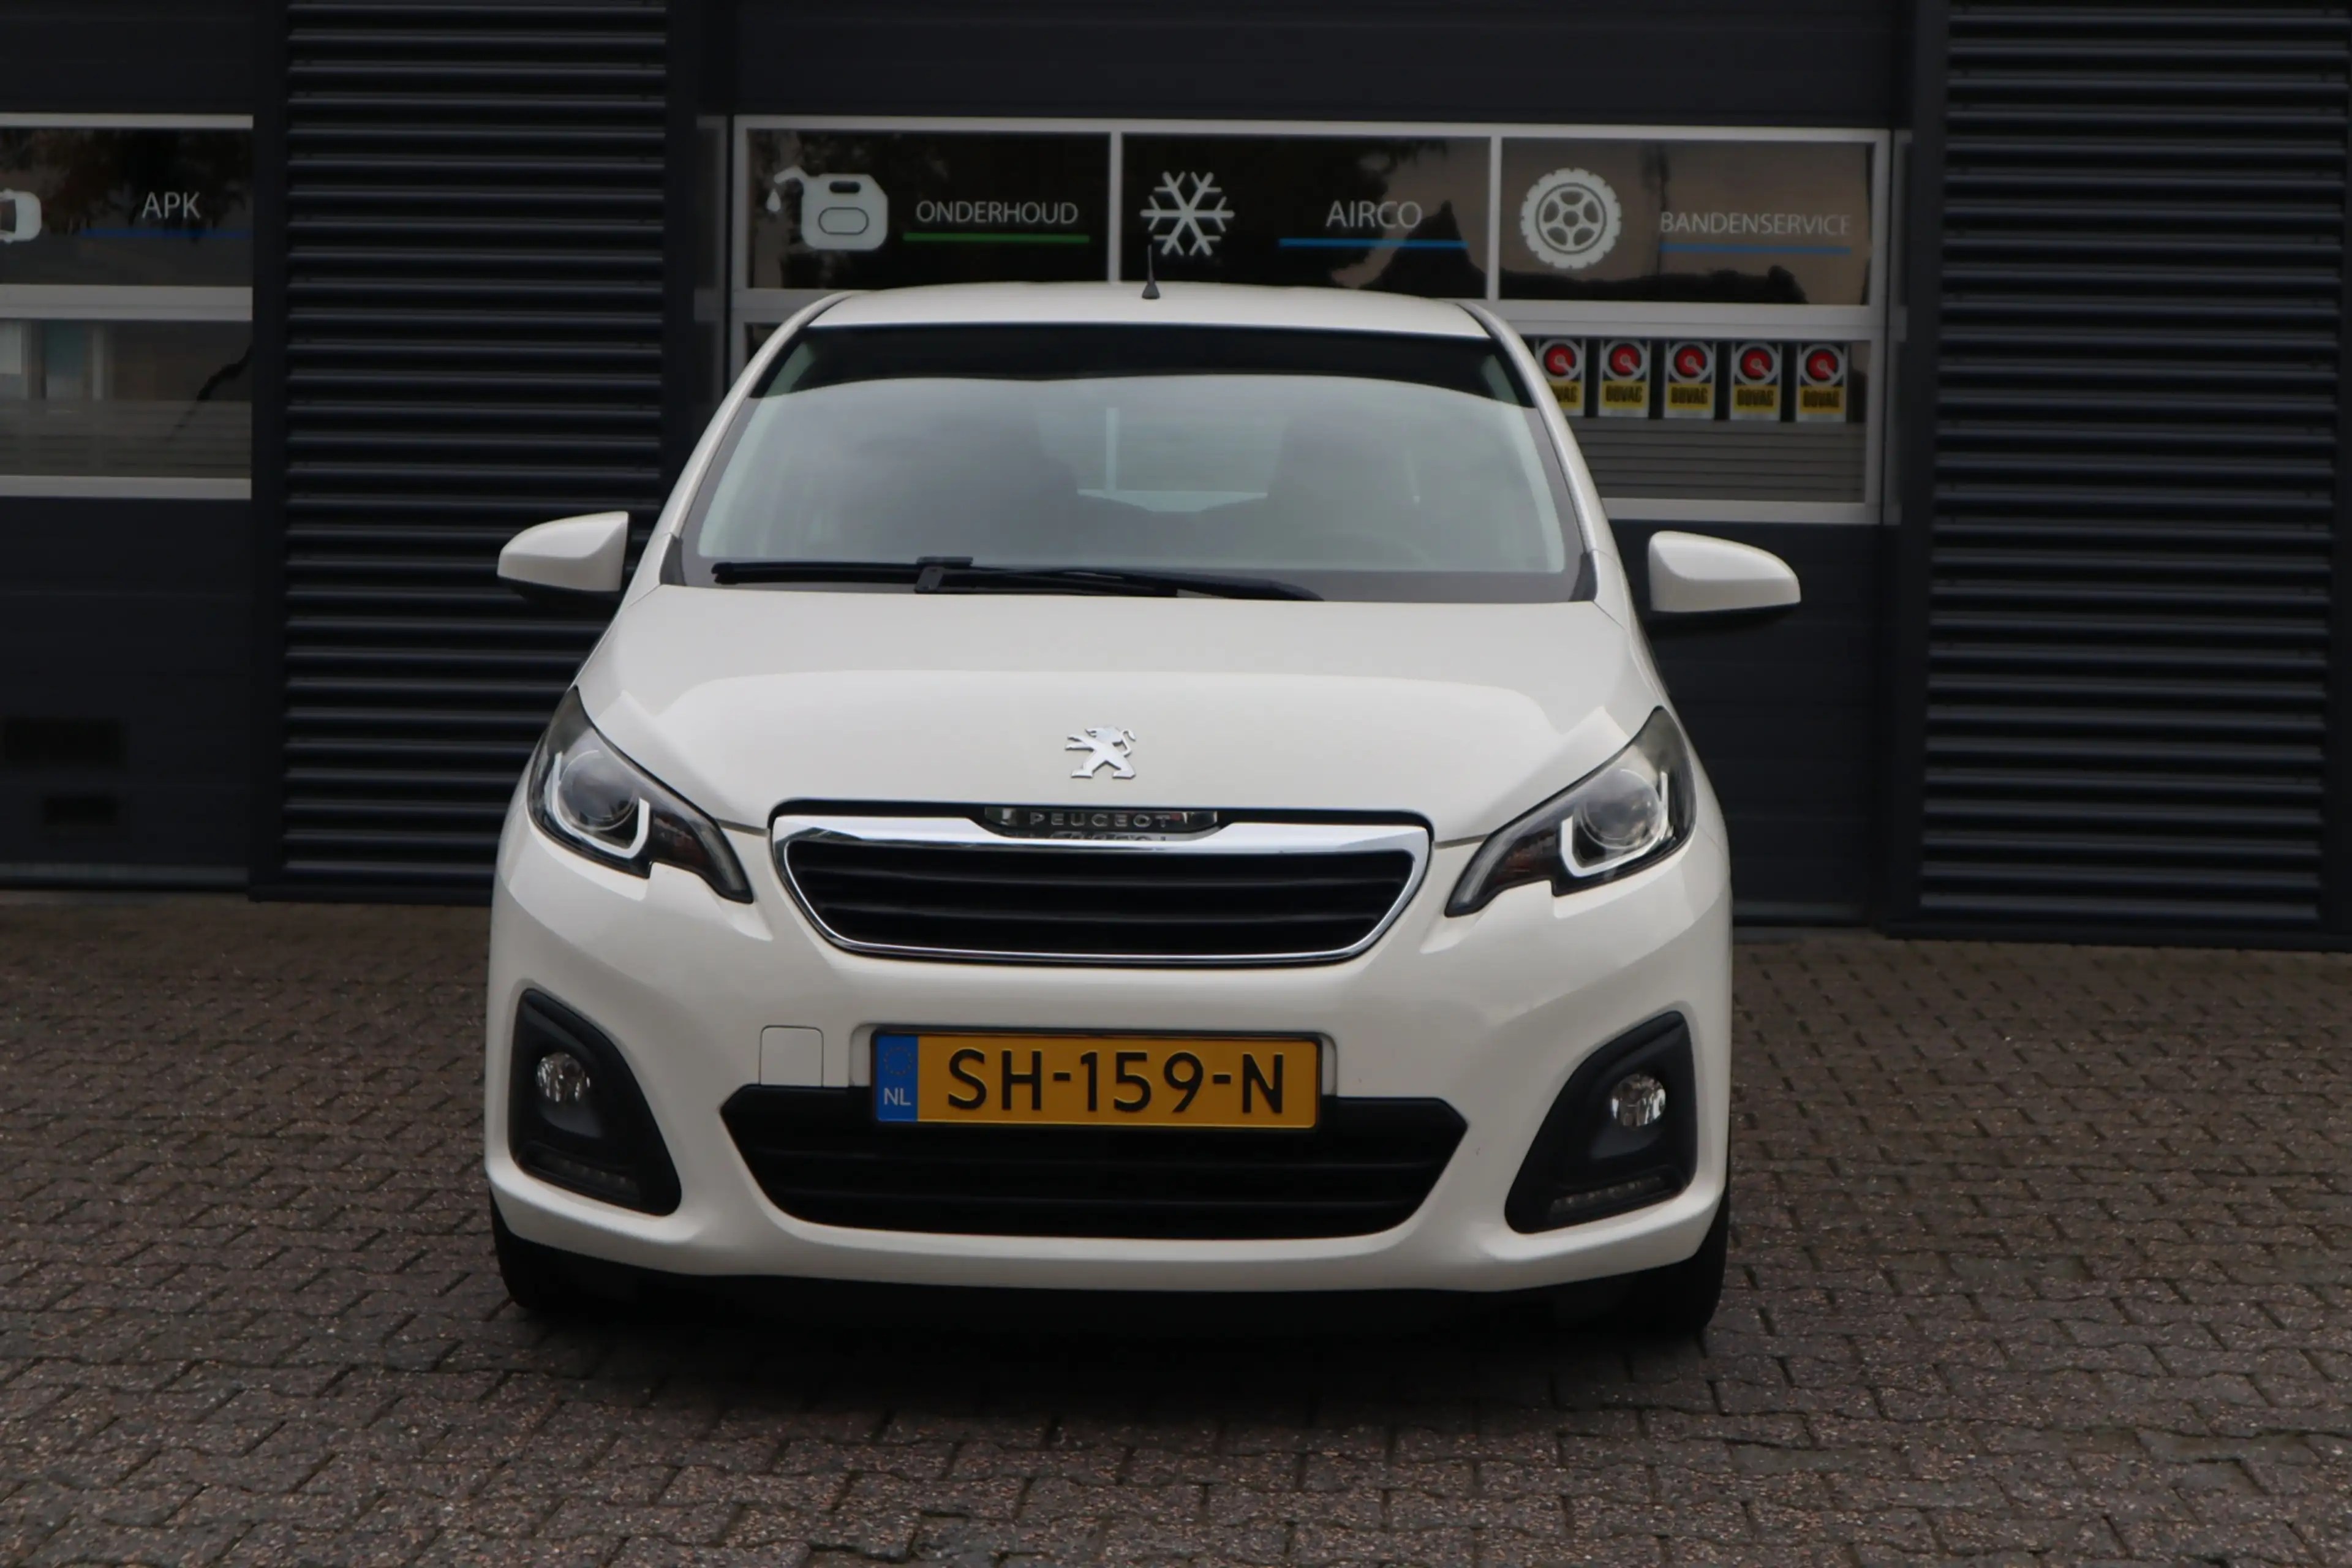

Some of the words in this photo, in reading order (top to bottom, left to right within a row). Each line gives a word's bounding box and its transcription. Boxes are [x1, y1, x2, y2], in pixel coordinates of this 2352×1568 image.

[141, 191, 201, 219] APK
[915, 200, 1079, 225] ONDERHOUD
[1325, 200, 1423, 229] AIRCO
[1660, 211, 1852, 236] BANDENSERVICE
[1029, 812, 1170, 828] PEUGEOT
[948, 1047, 1284, 1114] SH-159-N
[883, 1087, 911, 1106] NL
